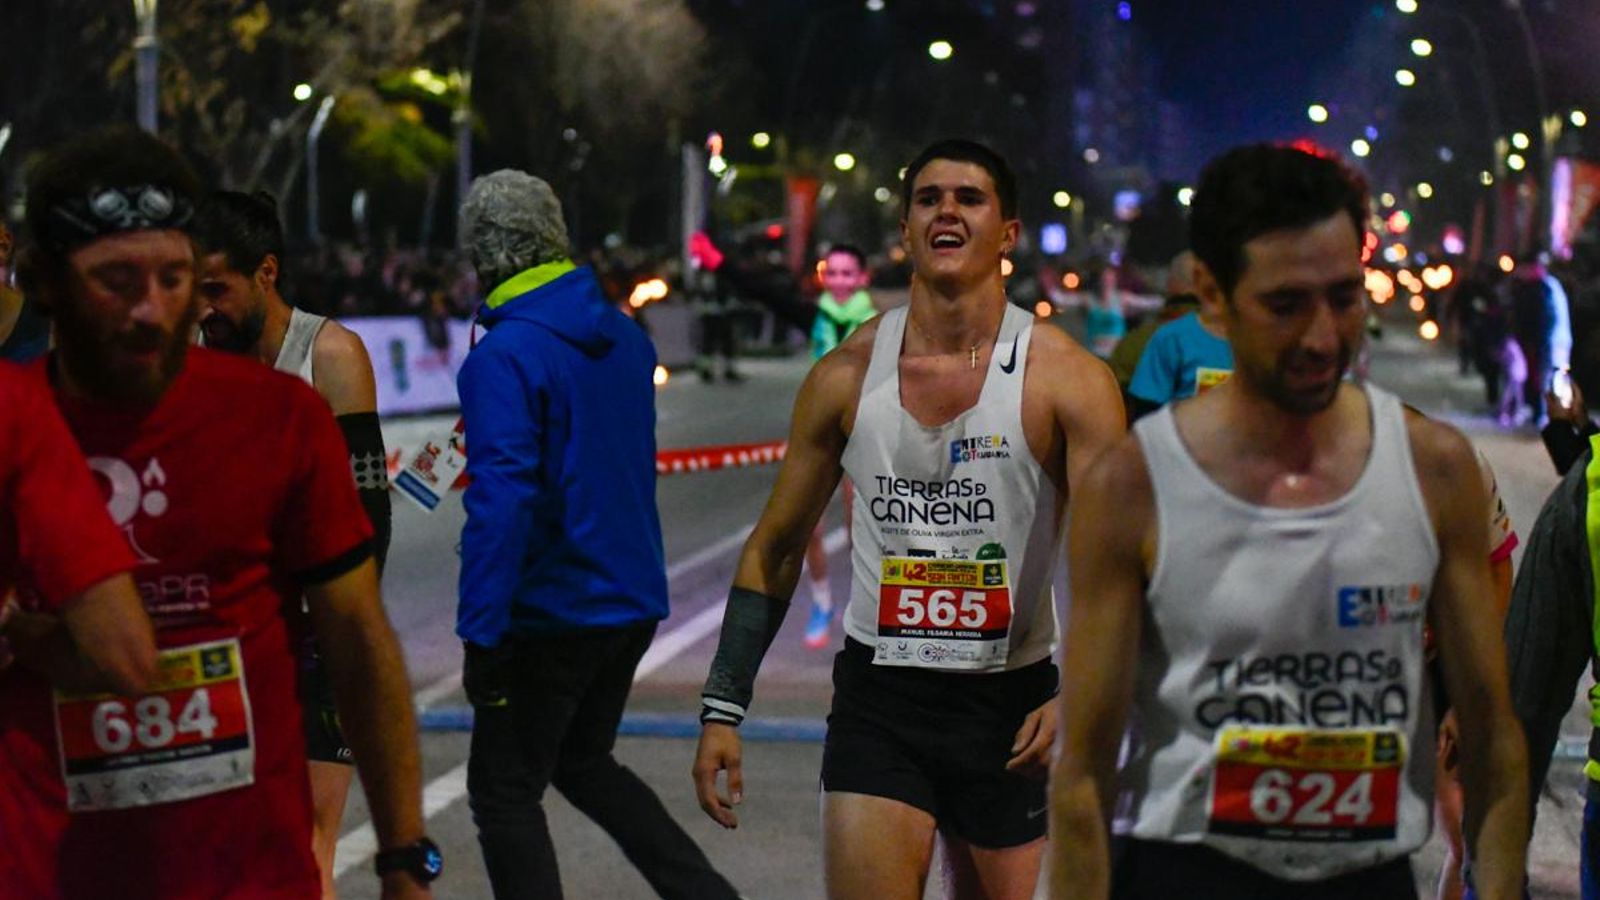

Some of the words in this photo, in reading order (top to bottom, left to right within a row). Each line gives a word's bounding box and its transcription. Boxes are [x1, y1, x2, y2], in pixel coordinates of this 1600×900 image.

[722, 441, 788, 465] ANTO
[911, 529, 932, 537] OLIVA
[934, 529, 960, 537] VIRGEN
[961, 528, 984, 536] EXTRA
[903, 562, 927, 581] 42
[897, 588, 988, 628] 565
[92, 688, 218, 752] 684
[1250, 768, 1374, 824] 624
